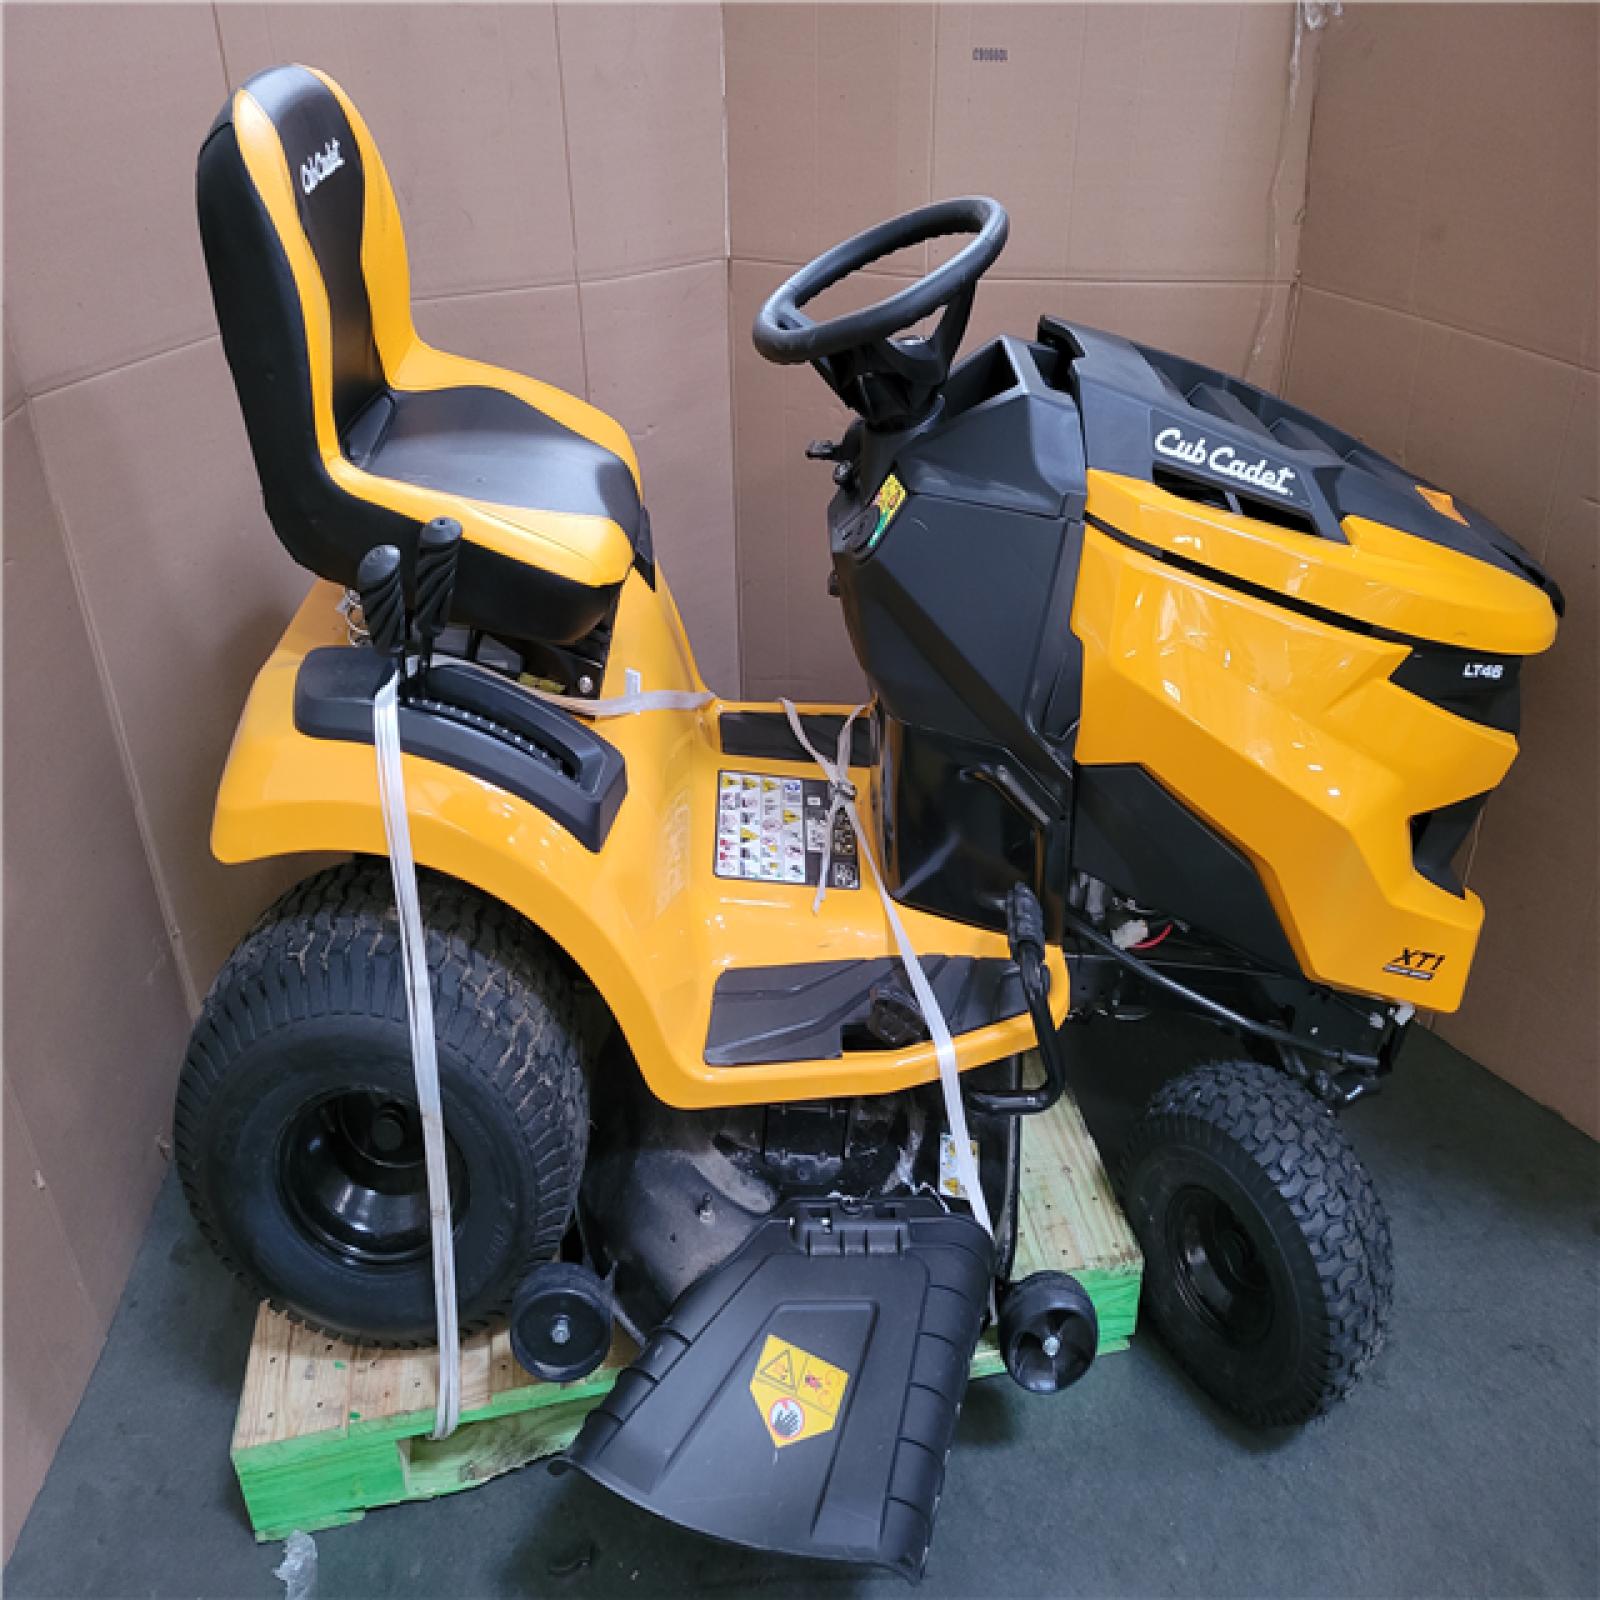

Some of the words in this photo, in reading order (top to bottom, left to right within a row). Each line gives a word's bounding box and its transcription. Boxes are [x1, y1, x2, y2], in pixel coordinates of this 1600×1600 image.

[1155, 428, 1206, 464] Cub
[1209, 447, 1296, 496] Cadet
[1392, 948, 1446, 971] XT1
